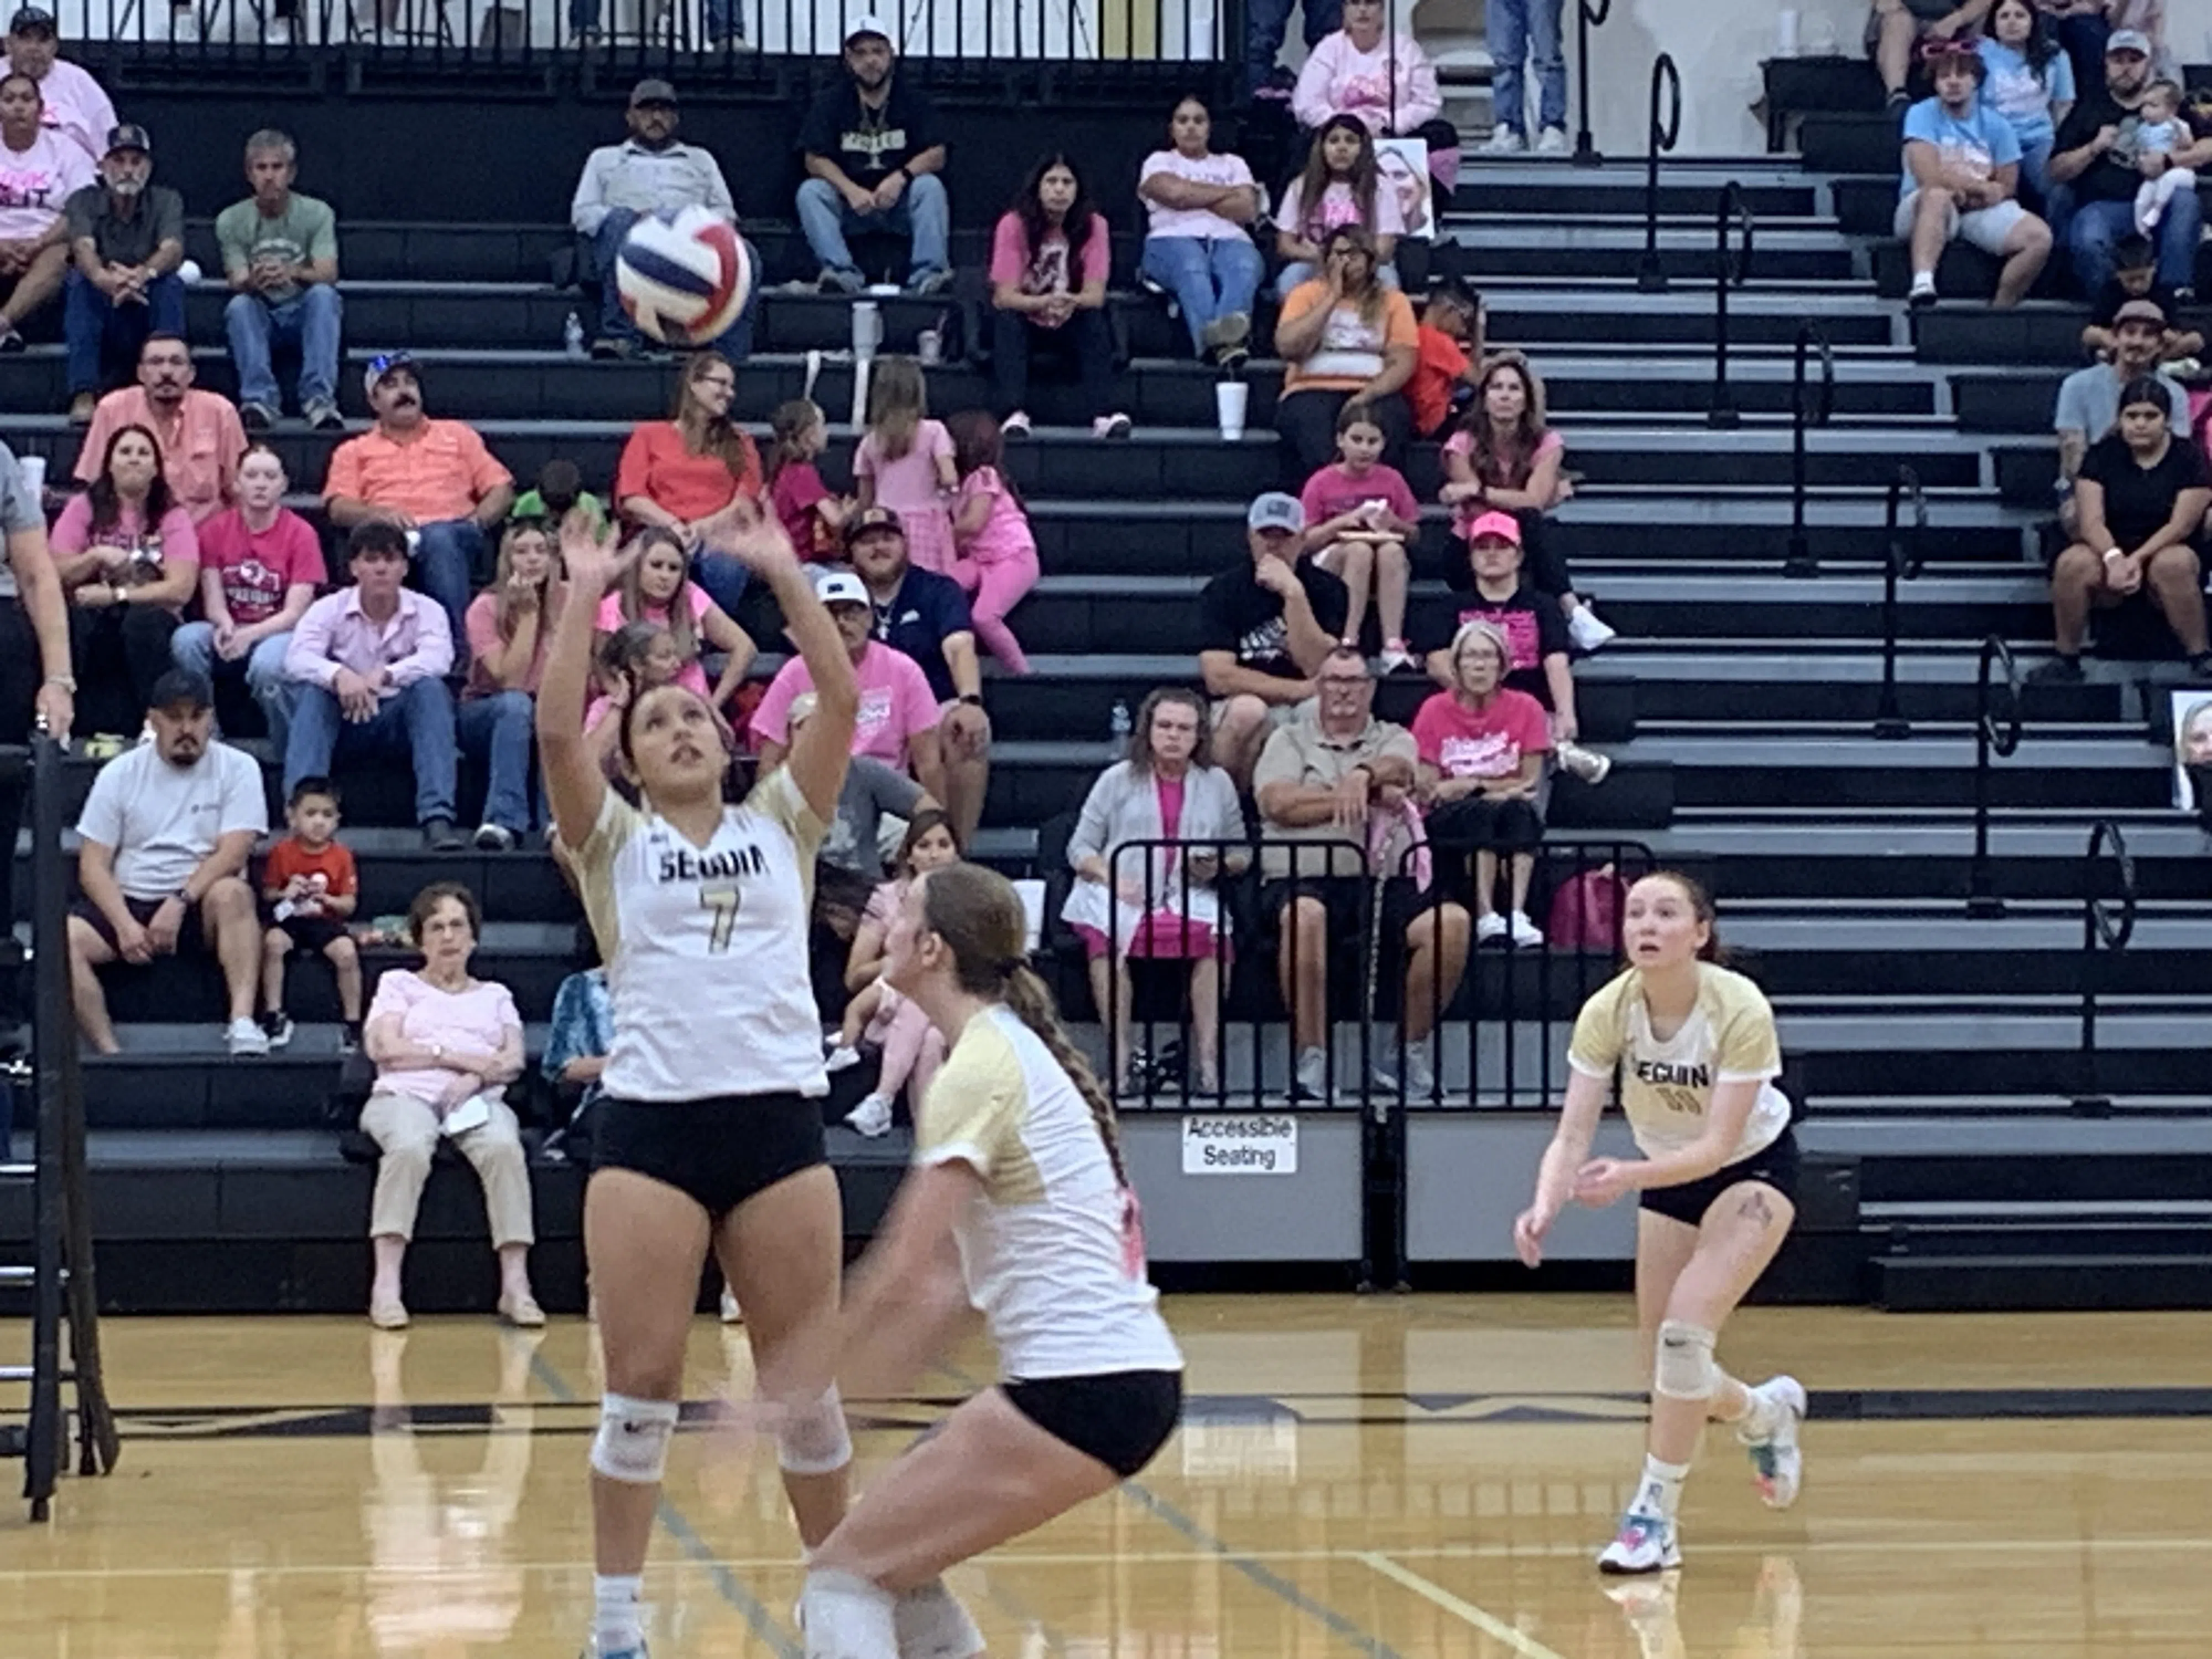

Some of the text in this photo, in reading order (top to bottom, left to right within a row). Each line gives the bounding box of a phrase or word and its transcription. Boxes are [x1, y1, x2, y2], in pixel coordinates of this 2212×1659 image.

[700, 885, 741, 954] 7
[1634, 1060, 1709, 1088] EGUIN
[1190, 1117, 1293, 1138] Accessible
[1203, 1144, 1276, 1170] Seating
